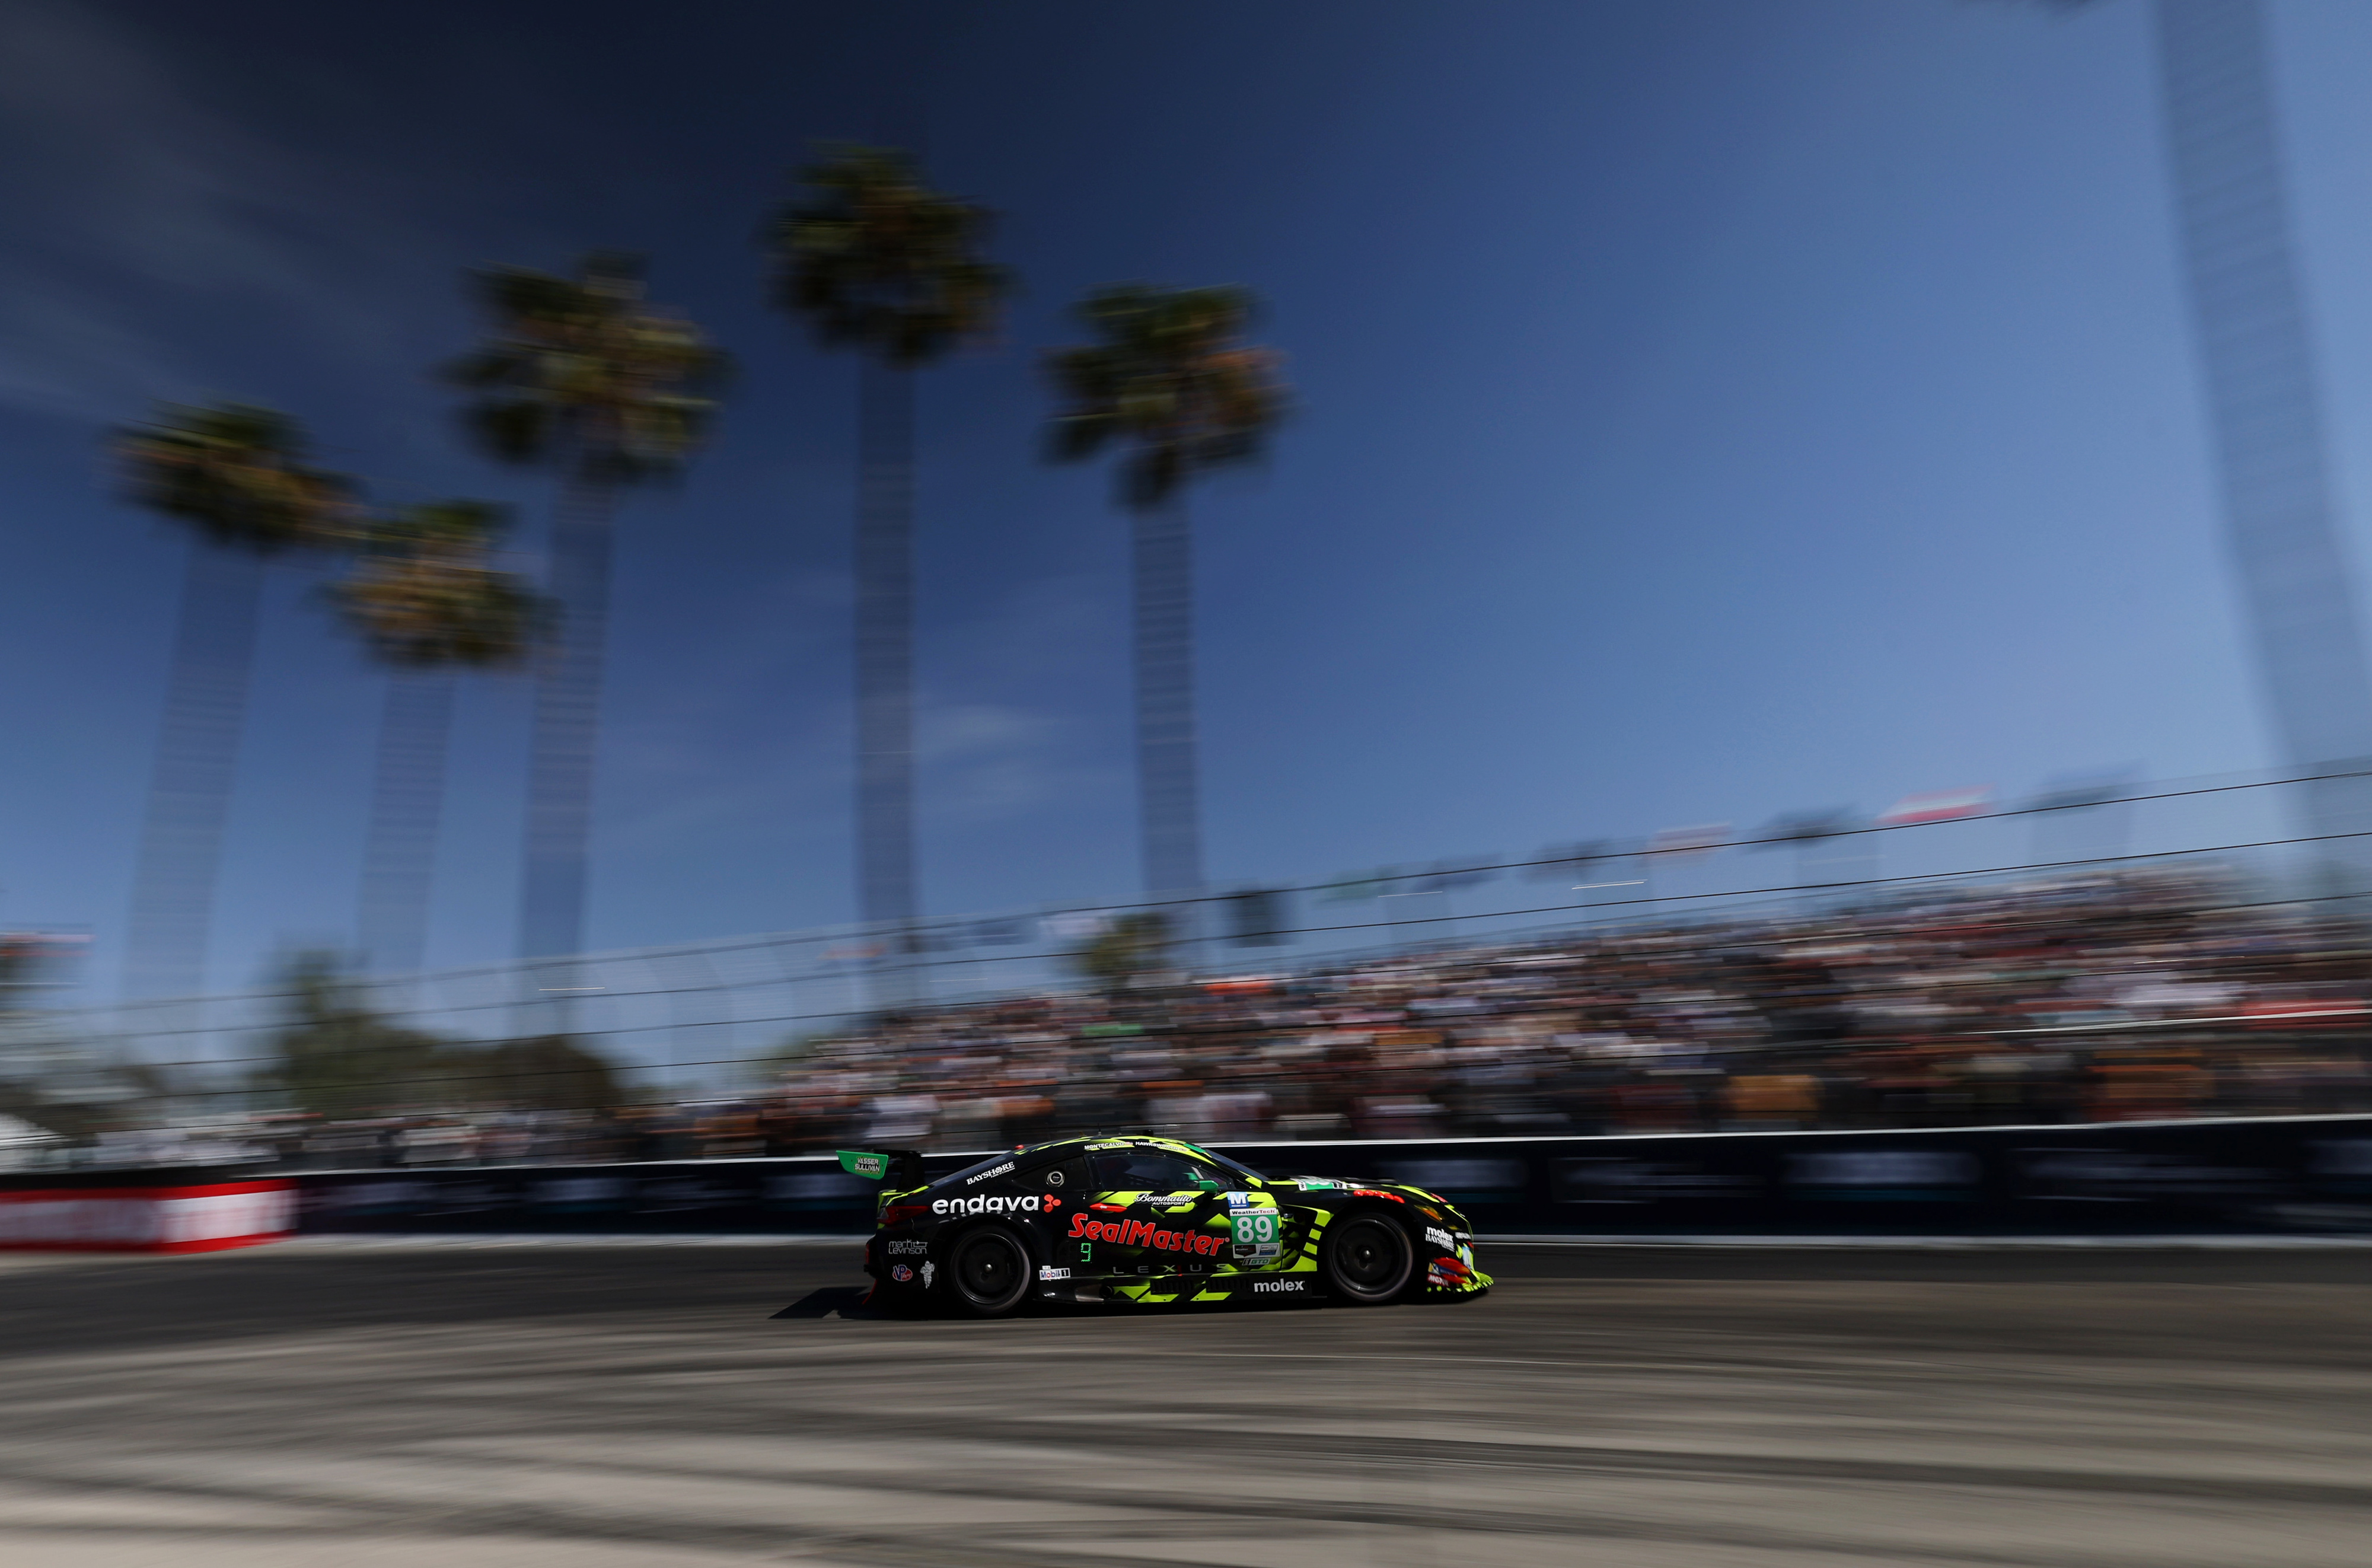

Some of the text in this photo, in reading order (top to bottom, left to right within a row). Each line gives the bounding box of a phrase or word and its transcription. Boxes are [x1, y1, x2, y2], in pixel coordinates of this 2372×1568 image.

[1084, 1142, 1124, 1150] MONTECALVO
[857, 1157, 879, 1165] VASSER
[855, 1164, 880, 1172] SULLIVAN
[966, 1161, 1015, 1185] BAYSHORE
[1134, 1193, 1193, 1203] Bommarito
[932, 1194, 1039, 1215] endava
[1237, 1216, 1273, 1243] 89
[1426, 1226, 1453, 1242] molex
[889, 1239, 912, 1248] mark
[1080, 1242, 1092, 1262] 9
[893, 1264, 907, 1281] VP
[1041, 1270, 1060, 1279] Mobil
[1112, 1264, 1232, 1274] LEXUS
[1254, 1278, 1305, 1292] molex
